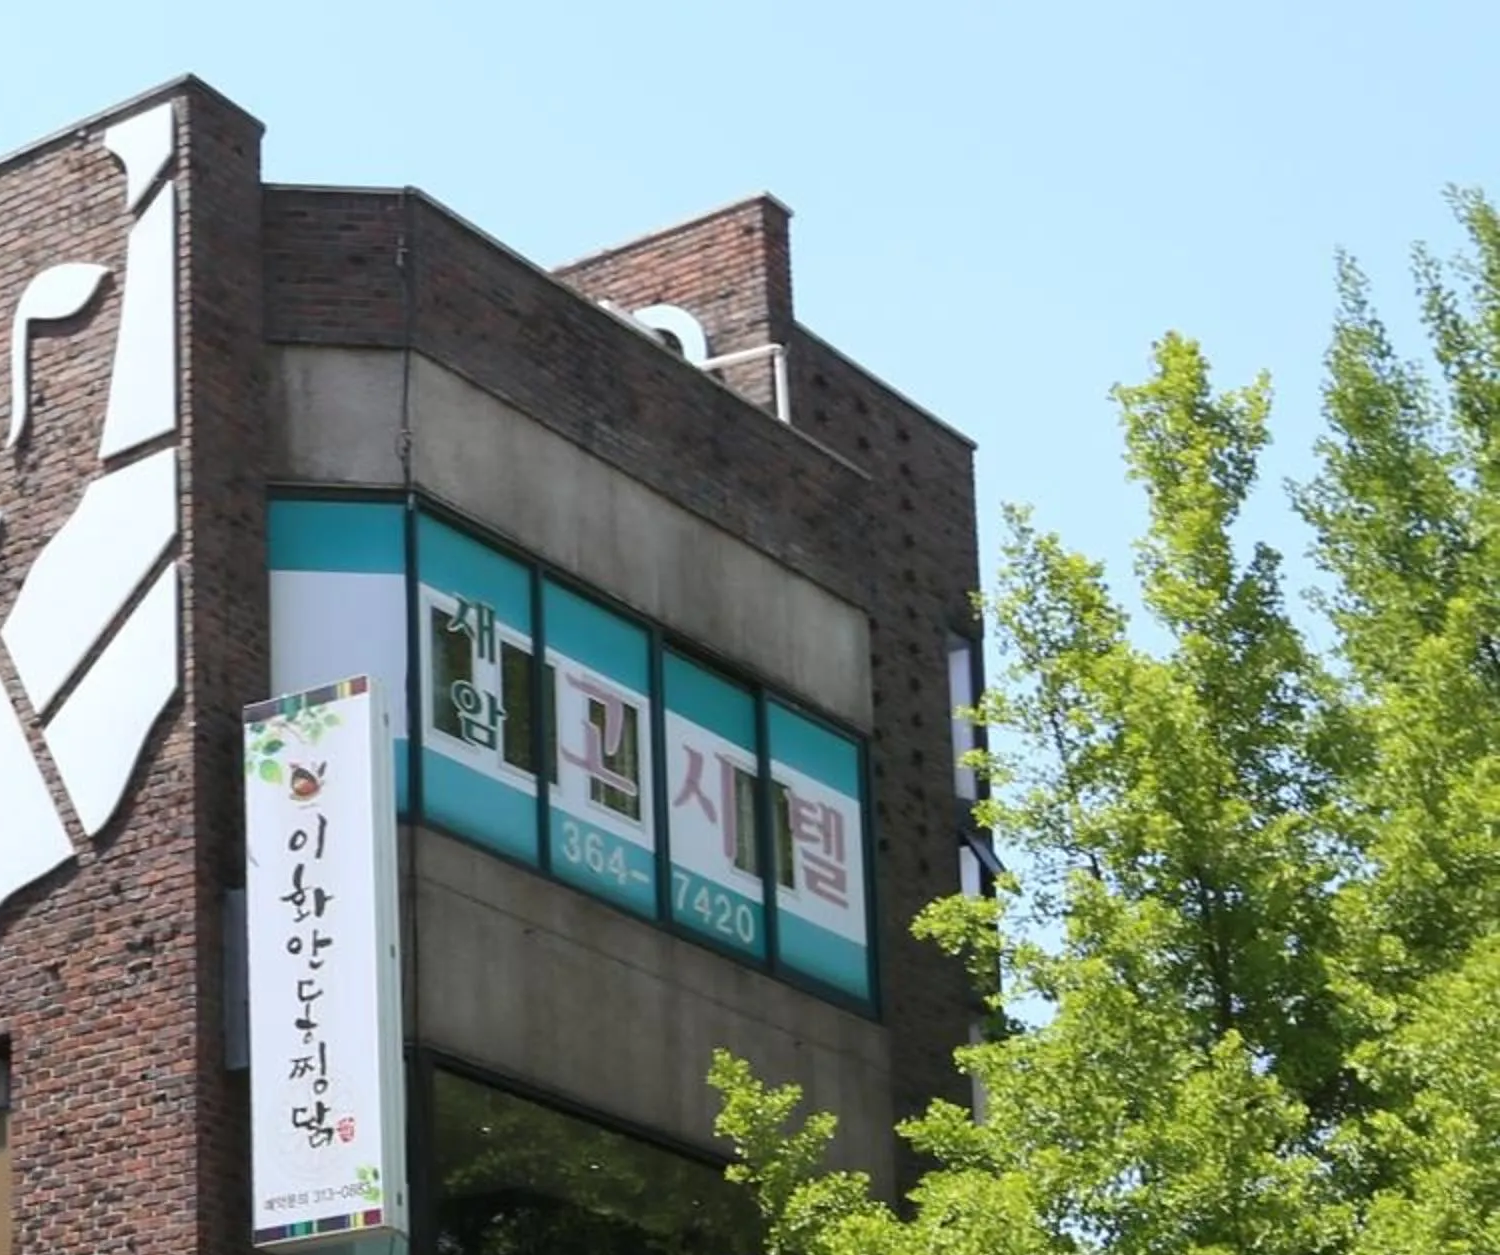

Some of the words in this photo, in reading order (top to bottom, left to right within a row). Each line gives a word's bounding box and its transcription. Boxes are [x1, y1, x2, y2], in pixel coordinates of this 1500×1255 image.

[447, 592, 508, 753] 새암
[559, 669, 850, 910] 고시텔
[279, 813, 332, 1150] 이화안동찜닭
